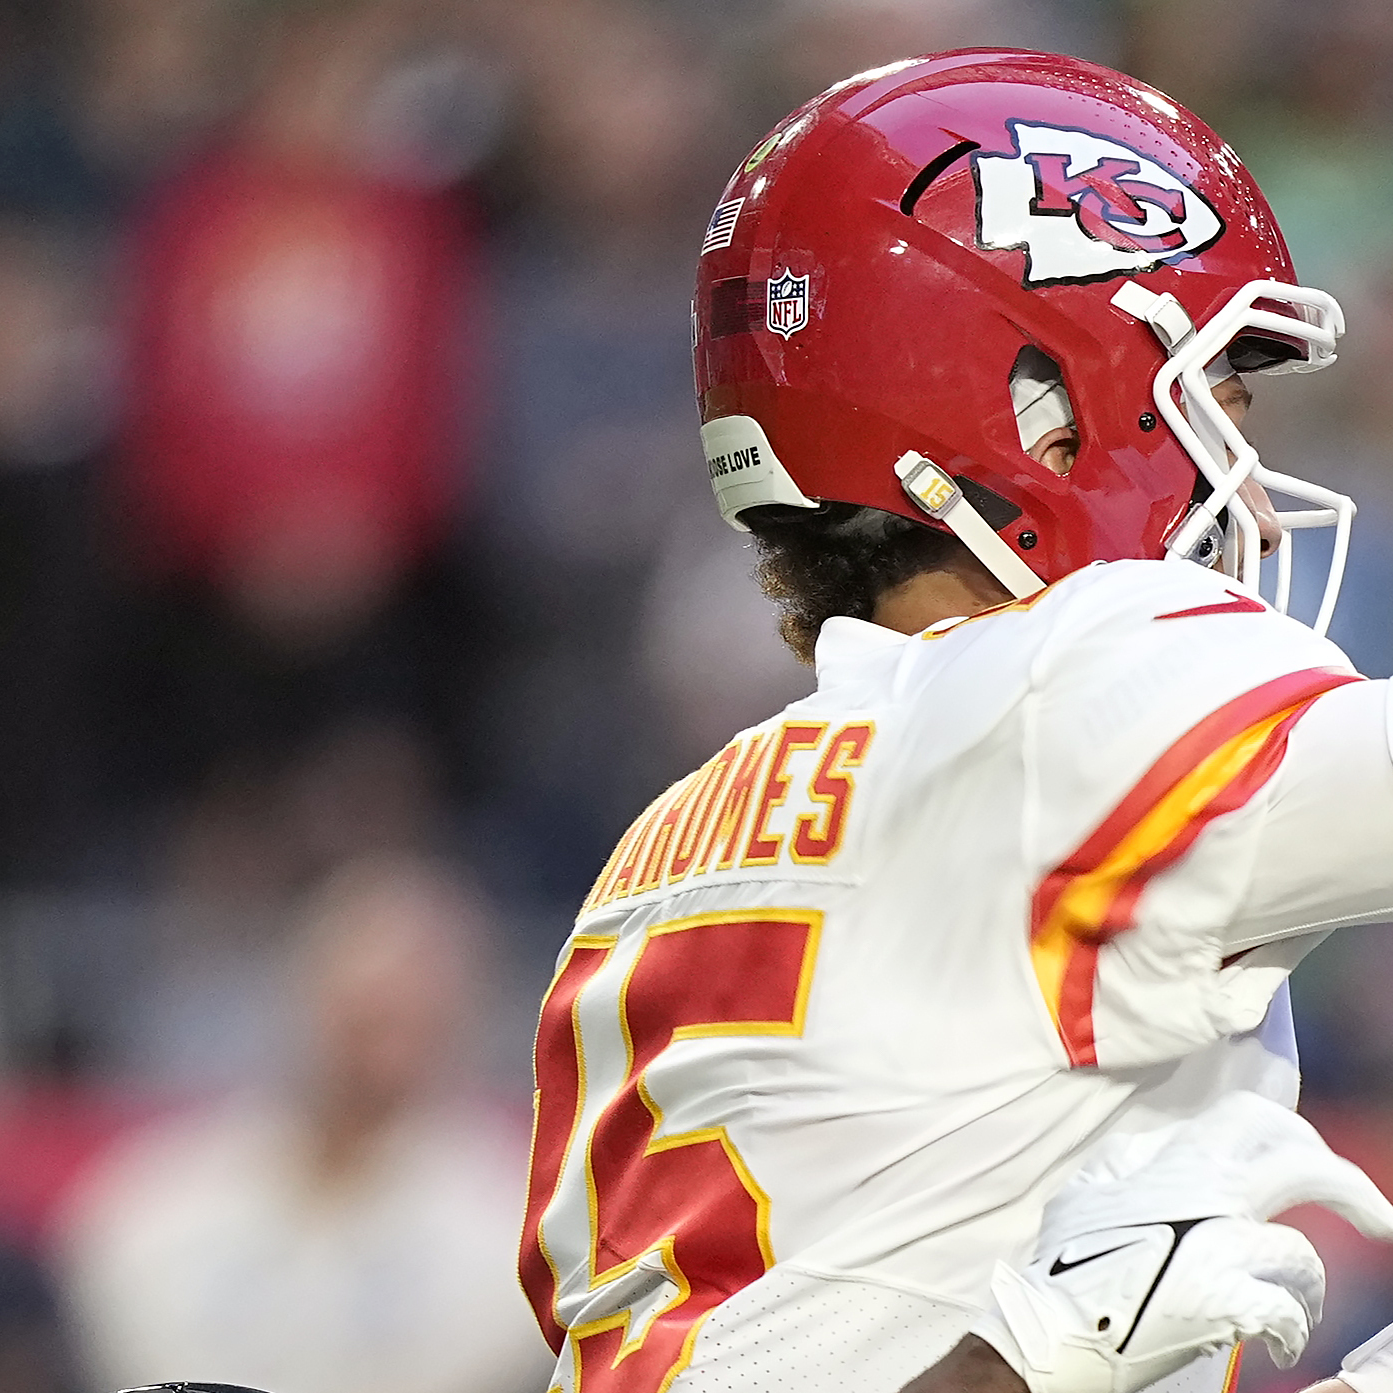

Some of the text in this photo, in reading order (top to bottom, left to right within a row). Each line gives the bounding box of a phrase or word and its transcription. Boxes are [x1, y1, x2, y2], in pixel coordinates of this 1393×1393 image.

[1024, 152, 1189, 254] KC
[772, 300, 802, 328] NFL
[727, 446, 761, 473] LOVE
[919, 477, 954, 509] 15
